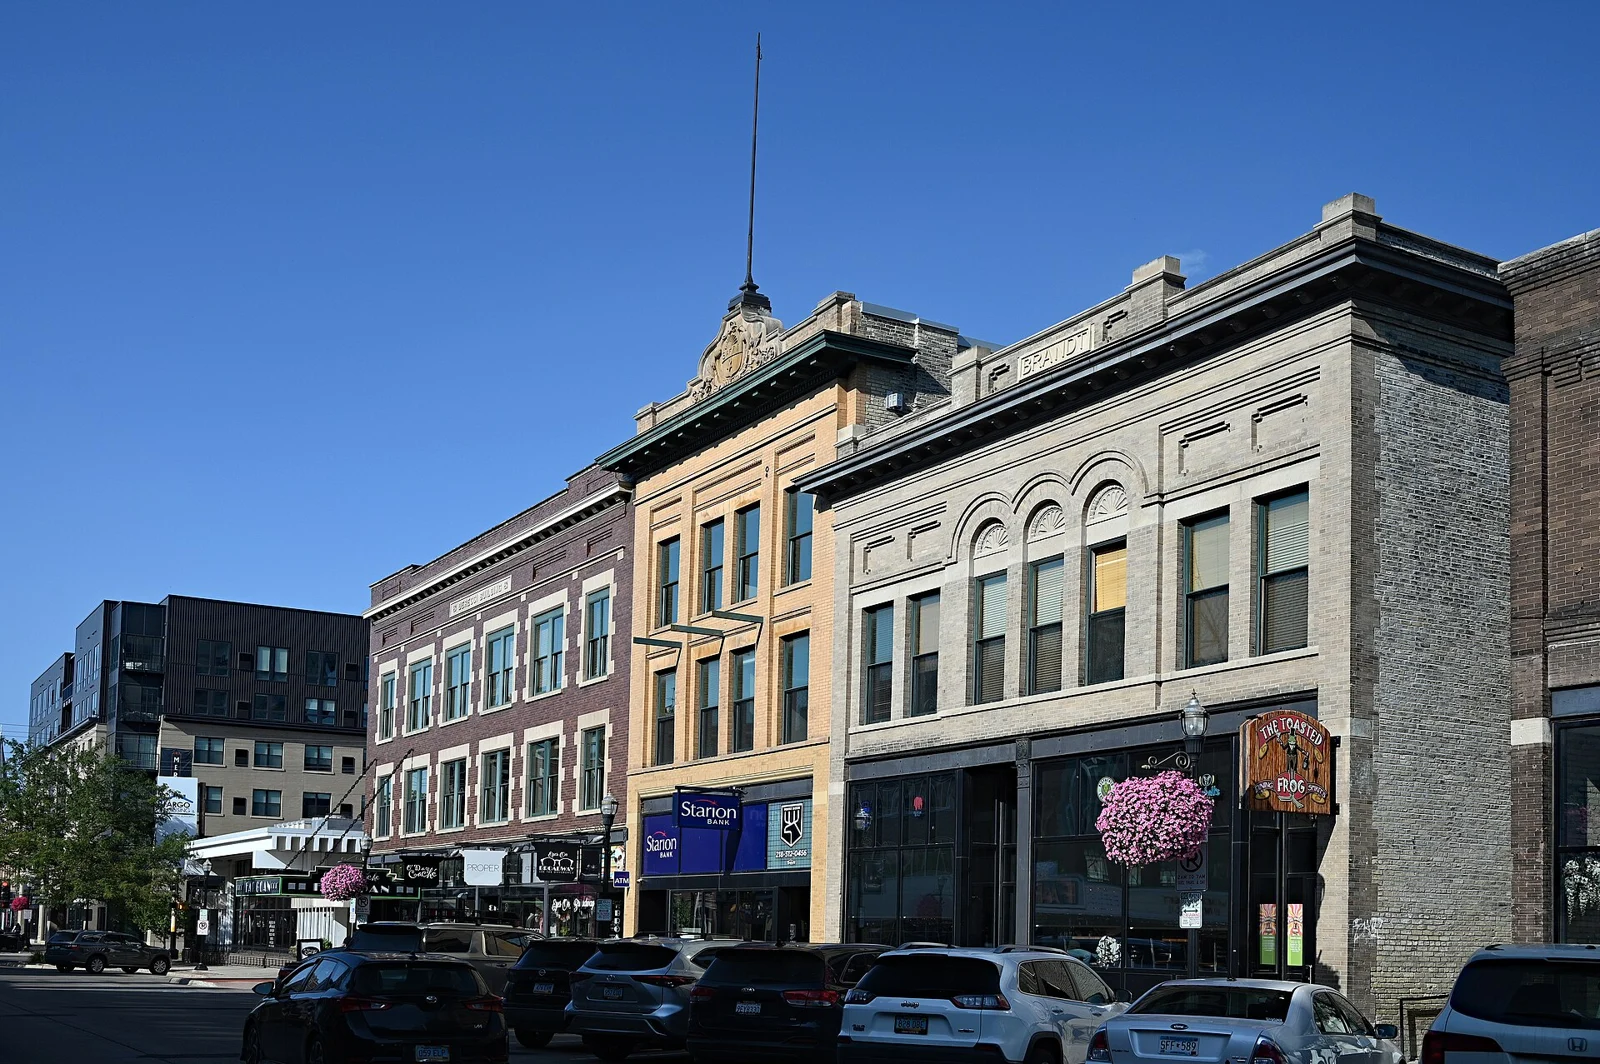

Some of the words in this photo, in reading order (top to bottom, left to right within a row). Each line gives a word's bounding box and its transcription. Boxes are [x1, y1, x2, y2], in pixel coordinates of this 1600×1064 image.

[1022, 331, 1088, 376] BRANDT
[1260, 719, 1278, 740] THE
[1280, 717, 1323, 746] TOASTED
[1277, 777, 1305, 793] FROG
[163, 801, 191, 809] ARGO
[681, 801, 737, 819] Starion
[707, 818, 730, 826] BANK
[646, 835, 677, 852] Starion
[659, 851, 673, 859] BANK
[466, 863, 500, 872] PROPER
[1160, 1040, 1176, 1050] SFF
[1181, 1040, 1197, 1051] 589
